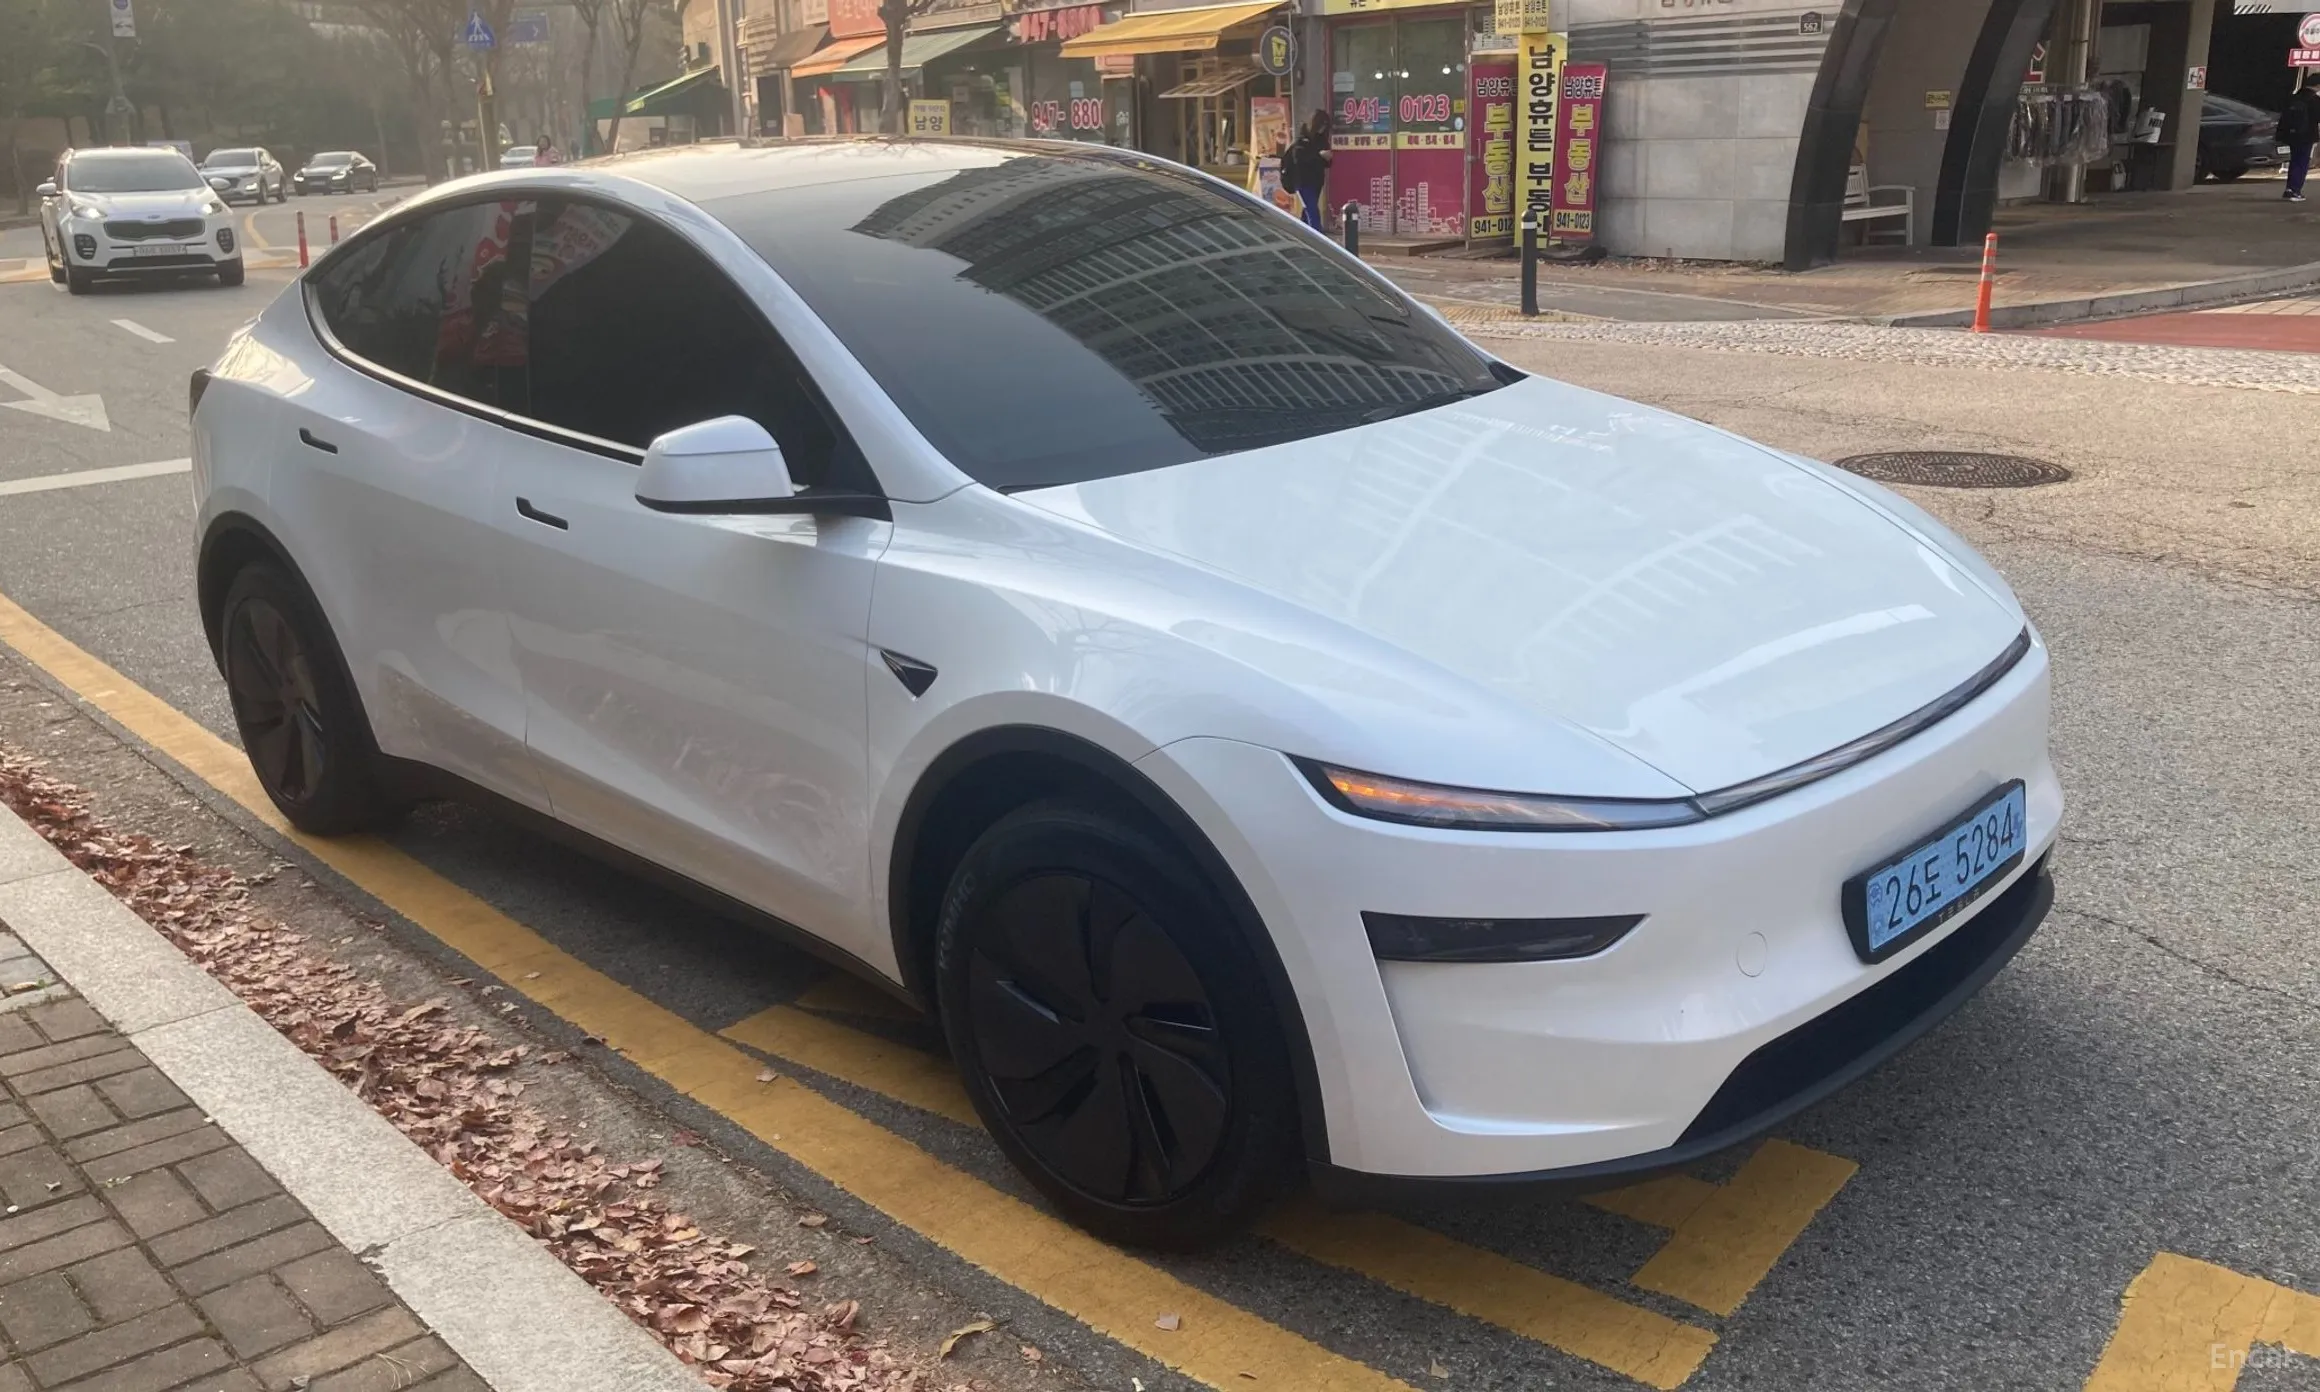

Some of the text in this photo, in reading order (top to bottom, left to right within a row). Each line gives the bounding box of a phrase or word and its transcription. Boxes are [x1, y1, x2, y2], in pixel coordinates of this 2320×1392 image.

[1071, 98, 1104, 130] 880
[1529, 44, 1556, 152] 남양휴튼
[1563, 76, 1603, 99] 남양휴튼
[914, 115, 943, 131] 남양
[1564, 104, 1593, 204] 부동산
[1483, 103, 1512, 213] 부동산
[1474, 218, 1514, 234] 941-012
[1556, 212, 1590, 229] 941-0123
[1886, 802, 2015, 930] 26도 5284
[938, 872, 977, 970] KUMHO
